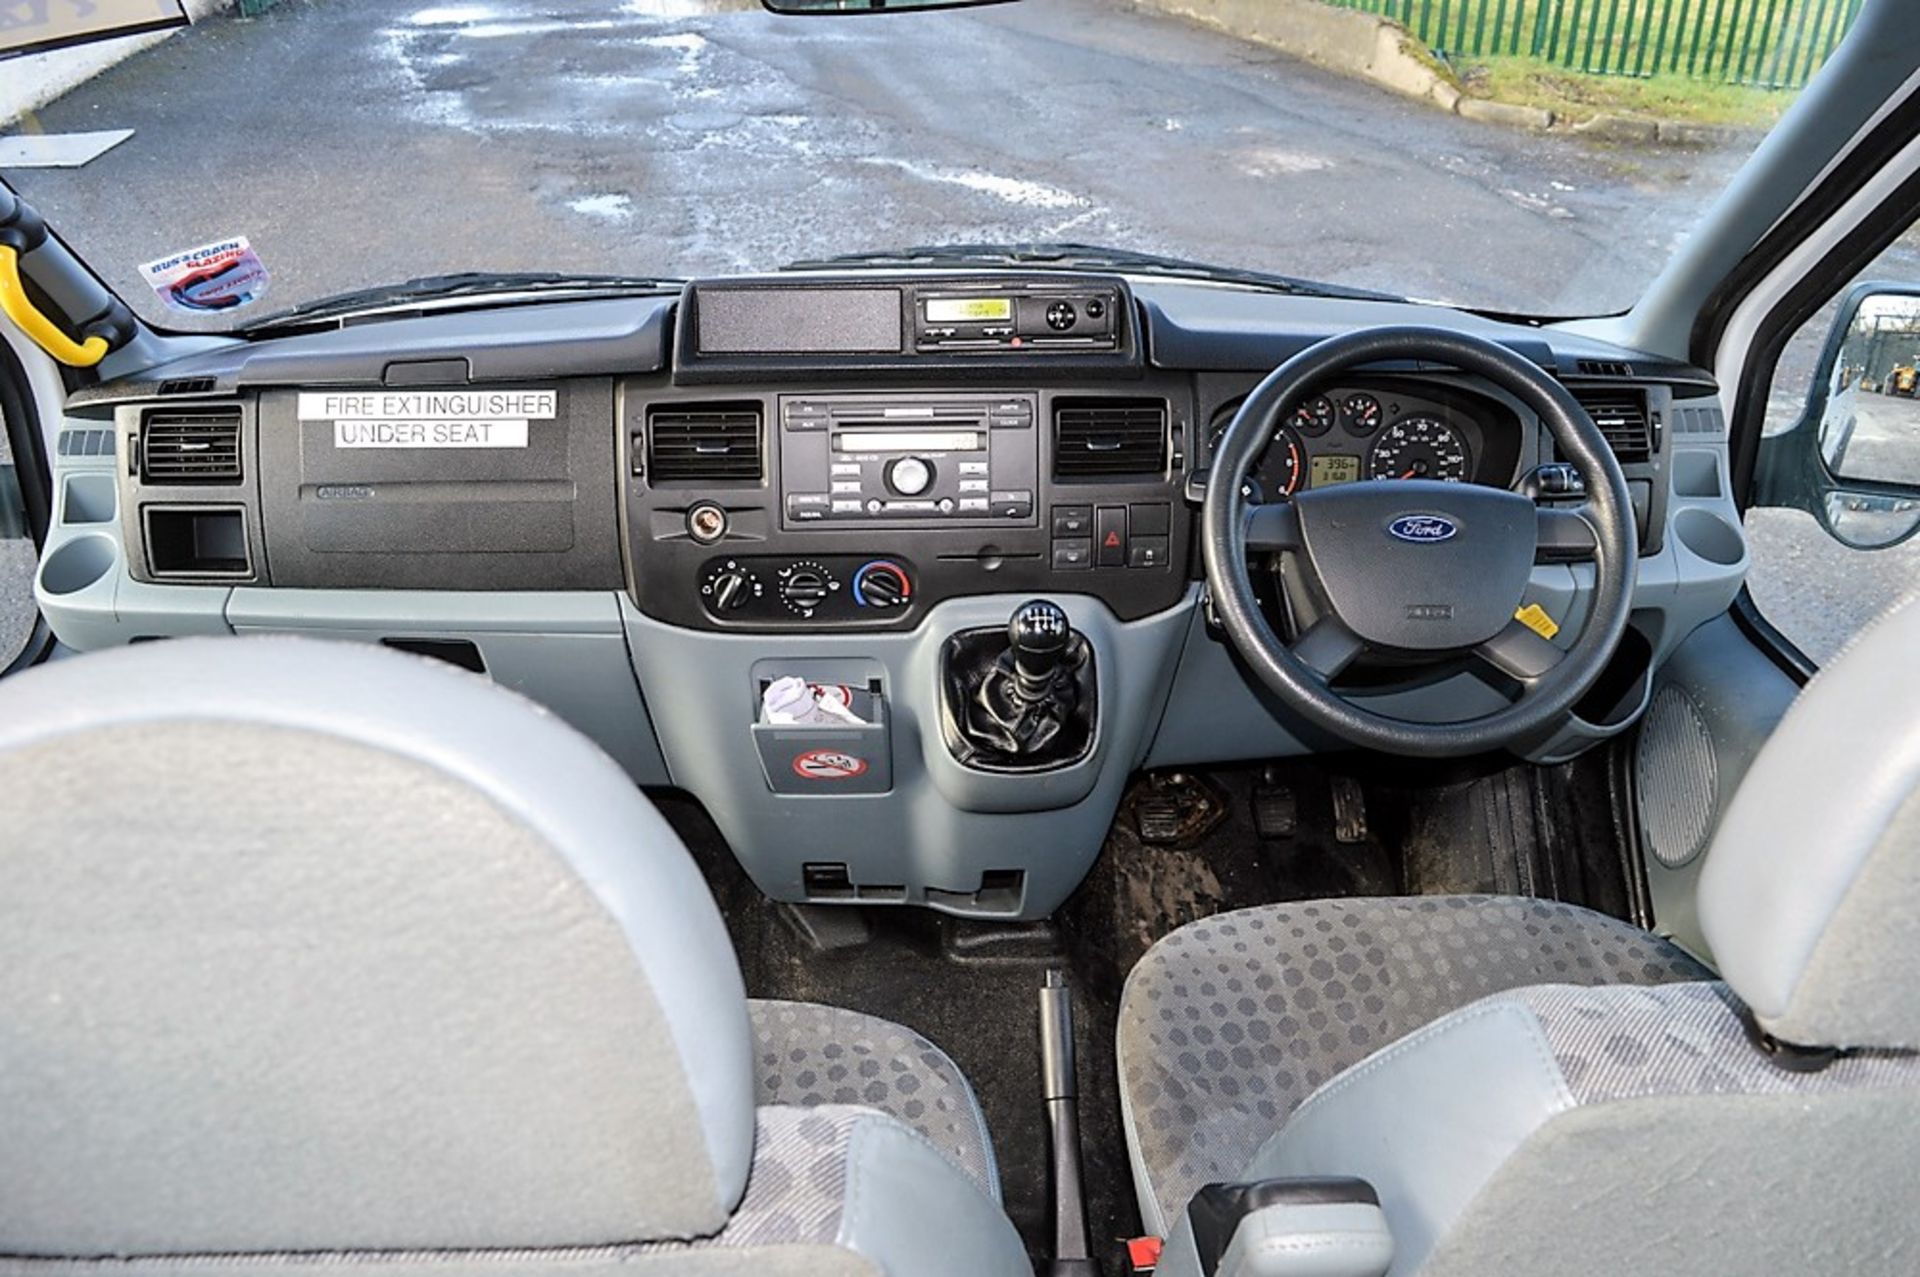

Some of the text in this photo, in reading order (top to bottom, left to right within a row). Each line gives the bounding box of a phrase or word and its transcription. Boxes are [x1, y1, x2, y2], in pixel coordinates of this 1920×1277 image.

[151, 259, 180, 273] BUS
[192, 242, 240, 260] COACH
[325, 394, 553, 415] FIRE EXTINGUISHER
[341, 423, 492, 444] UNDER SEAT
[1391, 429, 1405, 439] 50
[1416, 423, 1428, 431] 70
[1402, 518, 1444, 536] Ford
